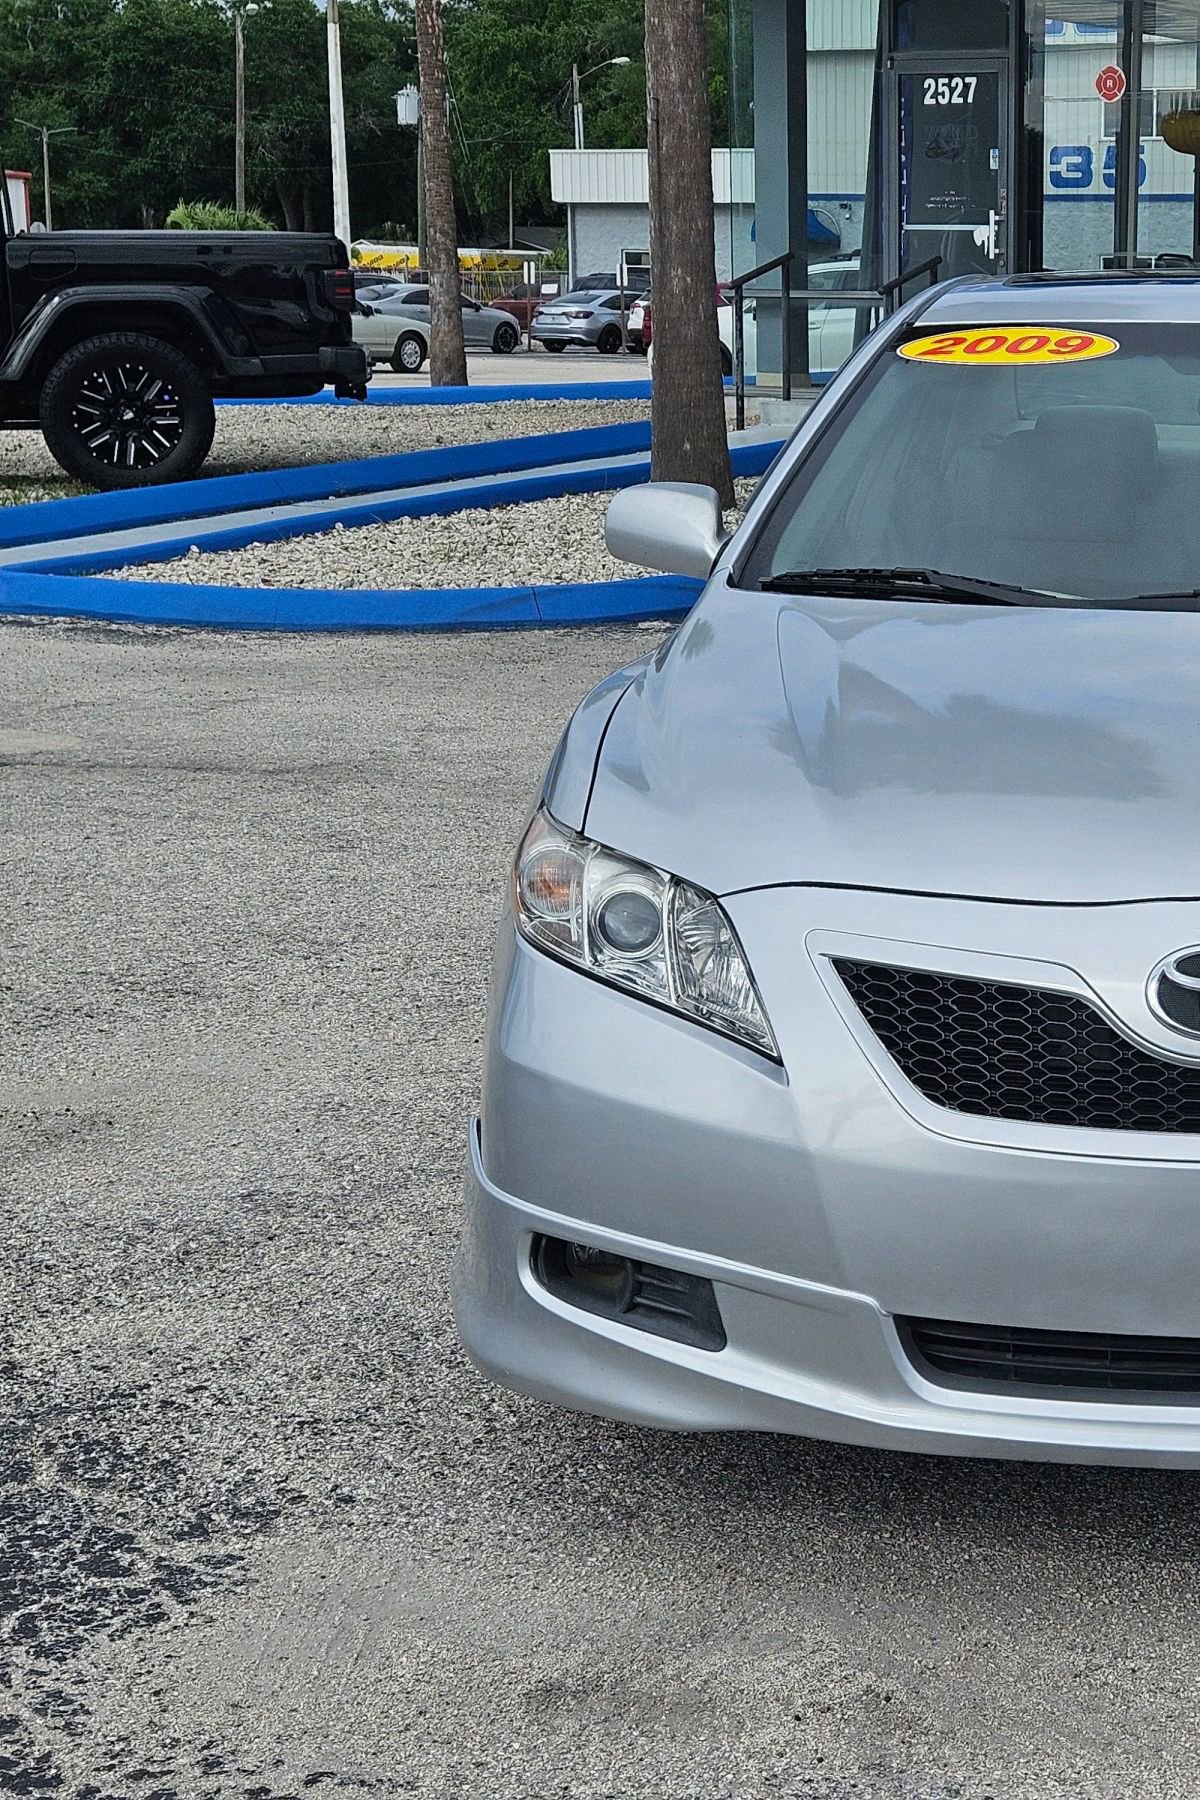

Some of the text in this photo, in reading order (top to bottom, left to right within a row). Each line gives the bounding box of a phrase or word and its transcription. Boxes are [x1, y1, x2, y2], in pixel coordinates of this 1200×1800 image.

[923, 76, 978, 105] 2527
[1106, 79, 1114, 88] R
[914, 335, 1097, 357] 2009
